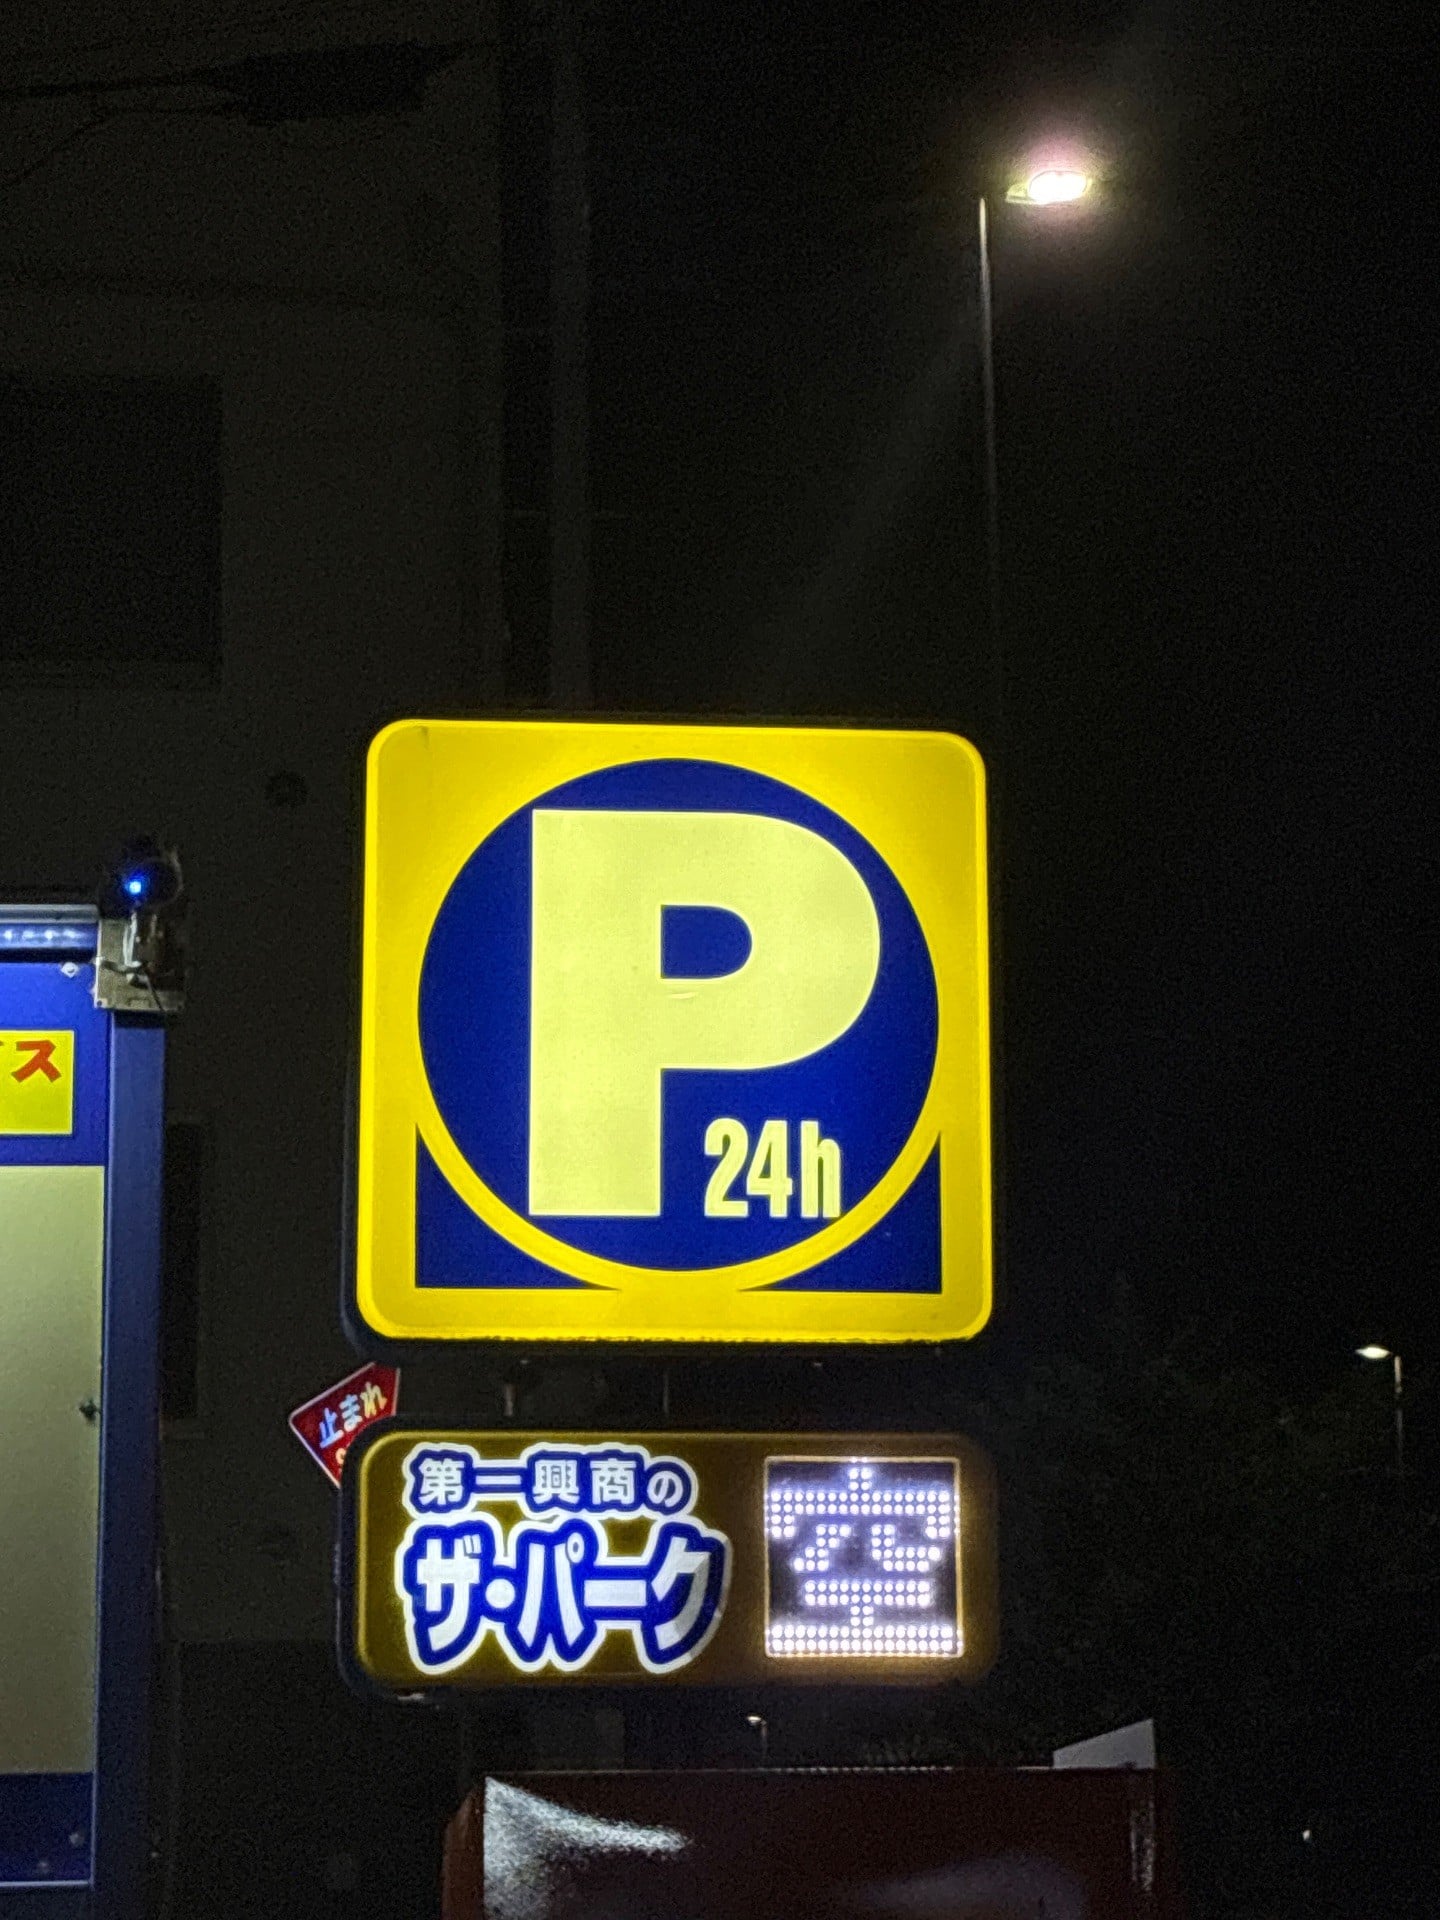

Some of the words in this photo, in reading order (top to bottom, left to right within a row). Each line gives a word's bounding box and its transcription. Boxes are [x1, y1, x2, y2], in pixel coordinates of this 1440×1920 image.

[0, 1040, 62, 1083] ス
[529, 809, 881, 1217] P
[703, 1117, 842, 1219] 24h
[319, 1382, 388, 1449] 止まれ
[417, 1457, 685, 1508] 第一興商の
[415, 1531, 712, 1652] ザ・パーク
[769, 1464, 954, 1652] 空
